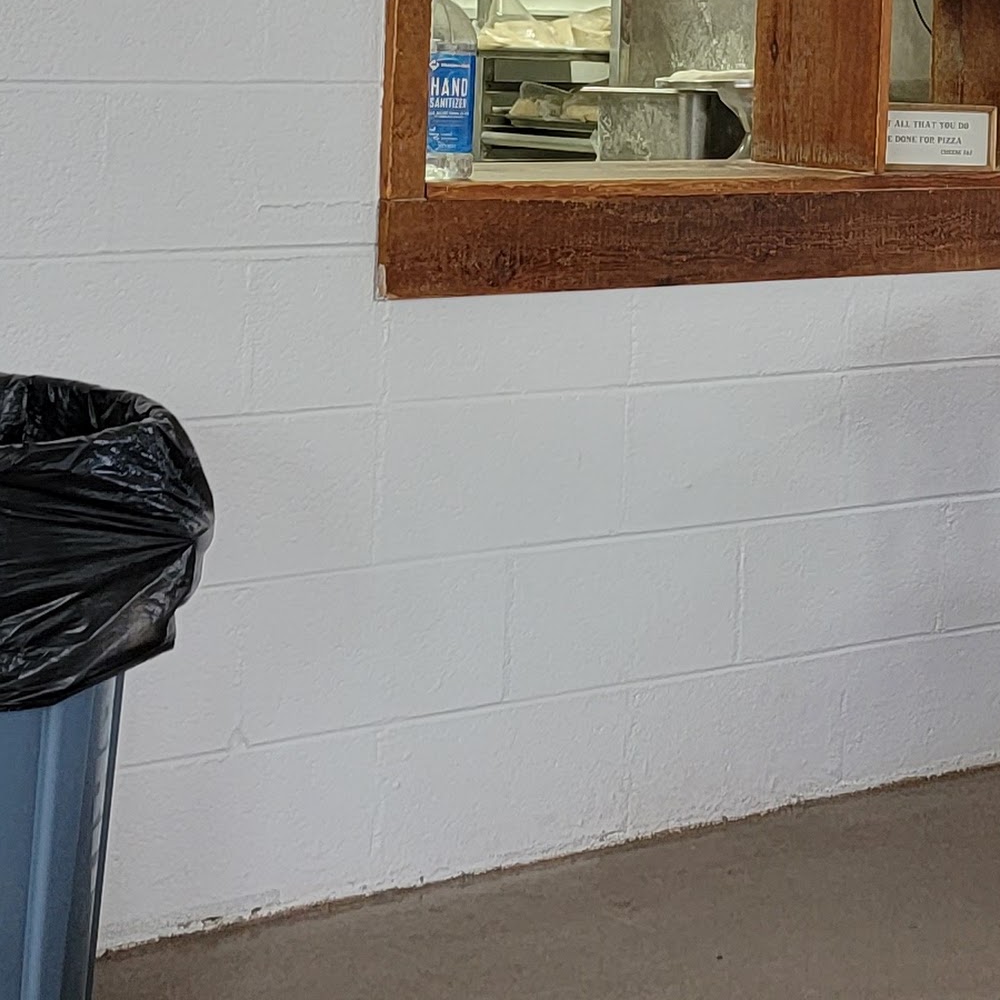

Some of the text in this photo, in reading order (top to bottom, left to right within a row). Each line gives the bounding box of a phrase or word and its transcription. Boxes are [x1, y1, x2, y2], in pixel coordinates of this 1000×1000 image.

[431, 77, 467, 96] HAND
[430, 98, 466, 108] SANITIZER
[920, 136, 935, 144] FOR
